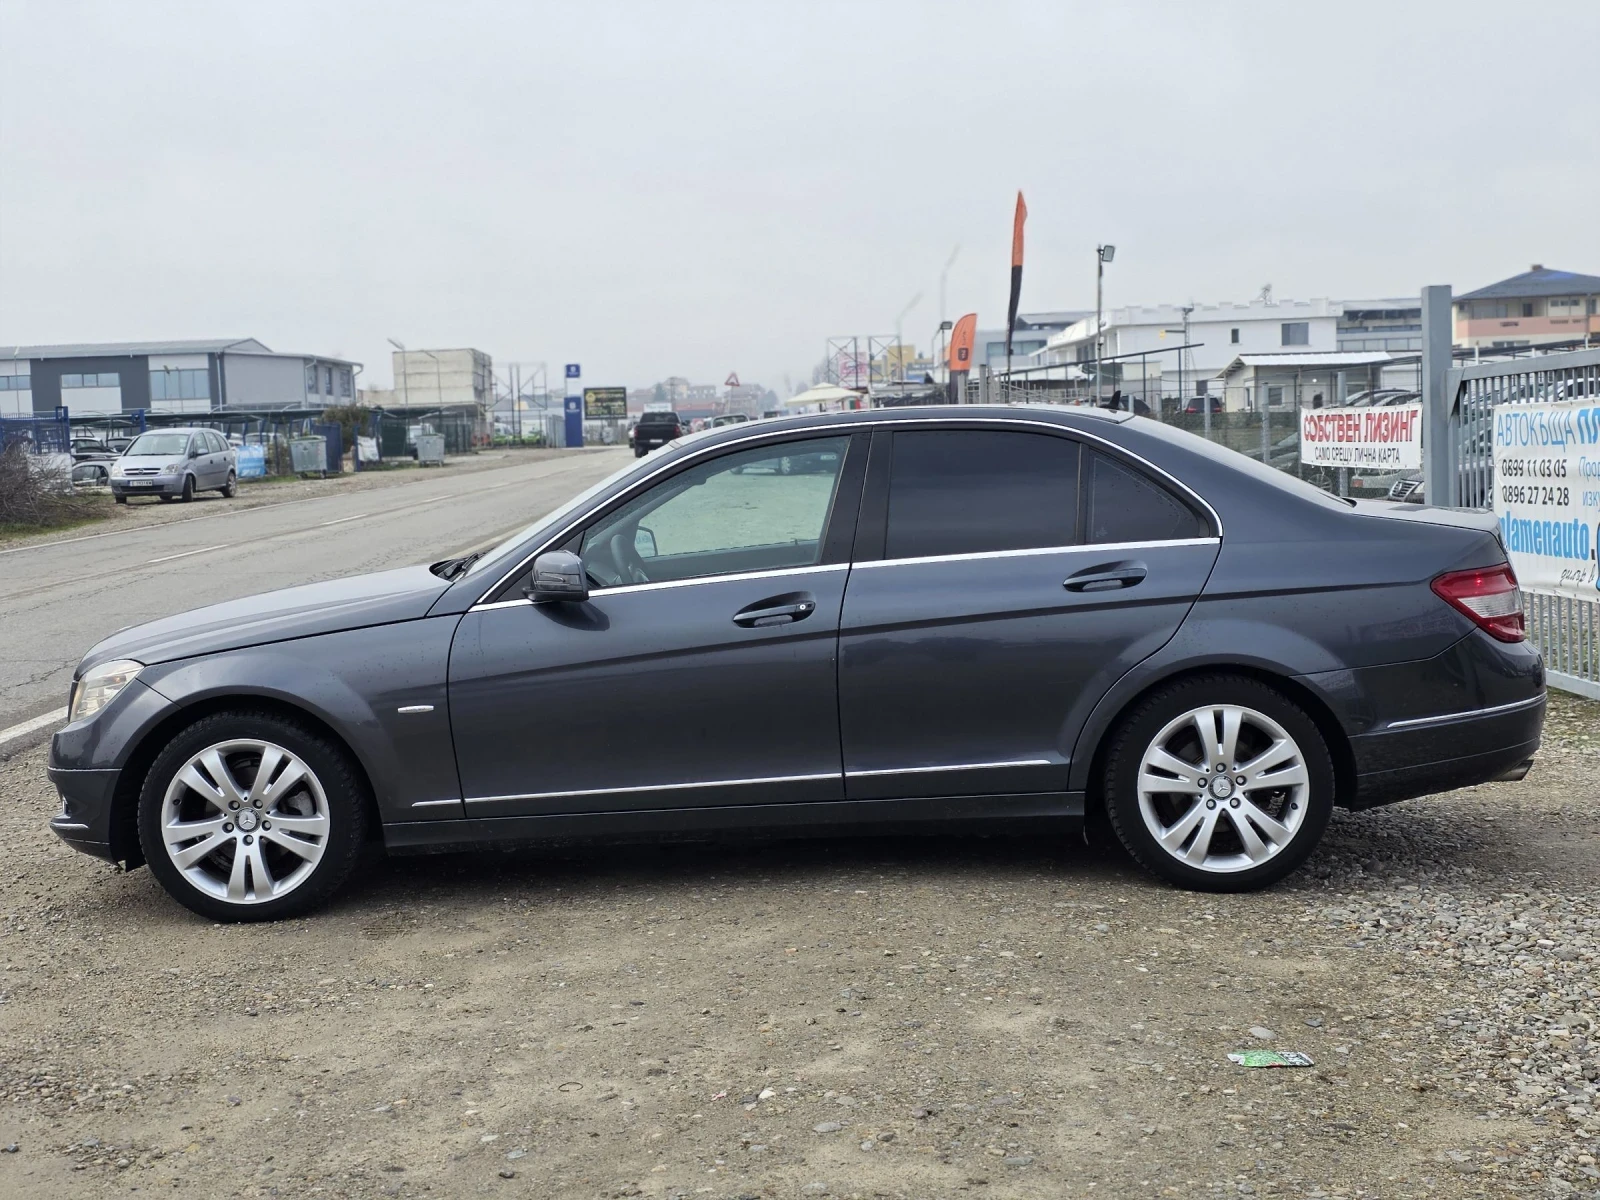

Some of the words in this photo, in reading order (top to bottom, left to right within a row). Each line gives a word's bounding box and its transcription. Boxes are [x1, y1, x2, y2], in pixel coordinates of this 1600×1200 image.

[1304, 413, 1361, 443] СОБСТВЕН
[1364, 409, 1419, 443] ЛИЗИНГ
[1497, 411, 1576, 452] АВТОКЪЩА
[1314, 446, 1331, 461] САМО
[1331, 447, 1353, 463] СРЕЩУ
[1354, 447, 1377, 463] ЛИЧНА
[1378, 448, 1401, 463] КАРТА
[1501, 459, 1524, 477] 0899
[1527, 459, 1538, 477] 11
[1539, 459, 1552, 478] 03
[1553, 459, 1568, 478] 05
[1502, 485, 1526, 504] 0896
[1527, 486, 1539, 505] 27
[1541, 486, 1555, 505] 24
[1556, 486, 1570, 506] 28
